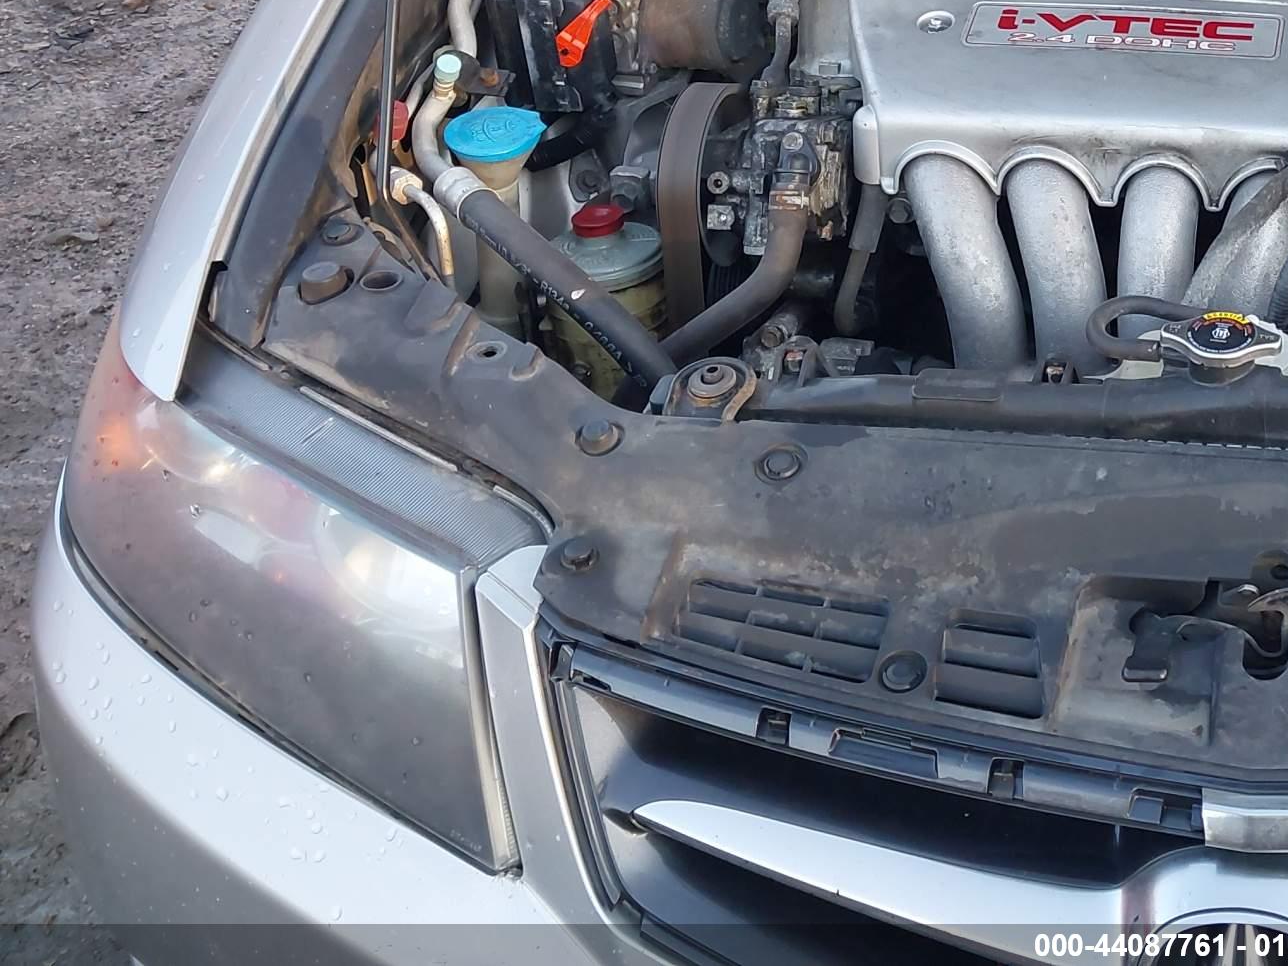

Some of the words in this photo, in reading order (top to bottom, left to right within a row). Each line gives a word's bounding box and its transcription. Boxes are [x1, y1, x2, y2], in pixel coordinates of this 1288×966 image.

[997, 8, 1256, 41] i-VTEC
[1007, 31, 1076, 44] 2.4
[1085, 33, 1237, 51] DOHC
